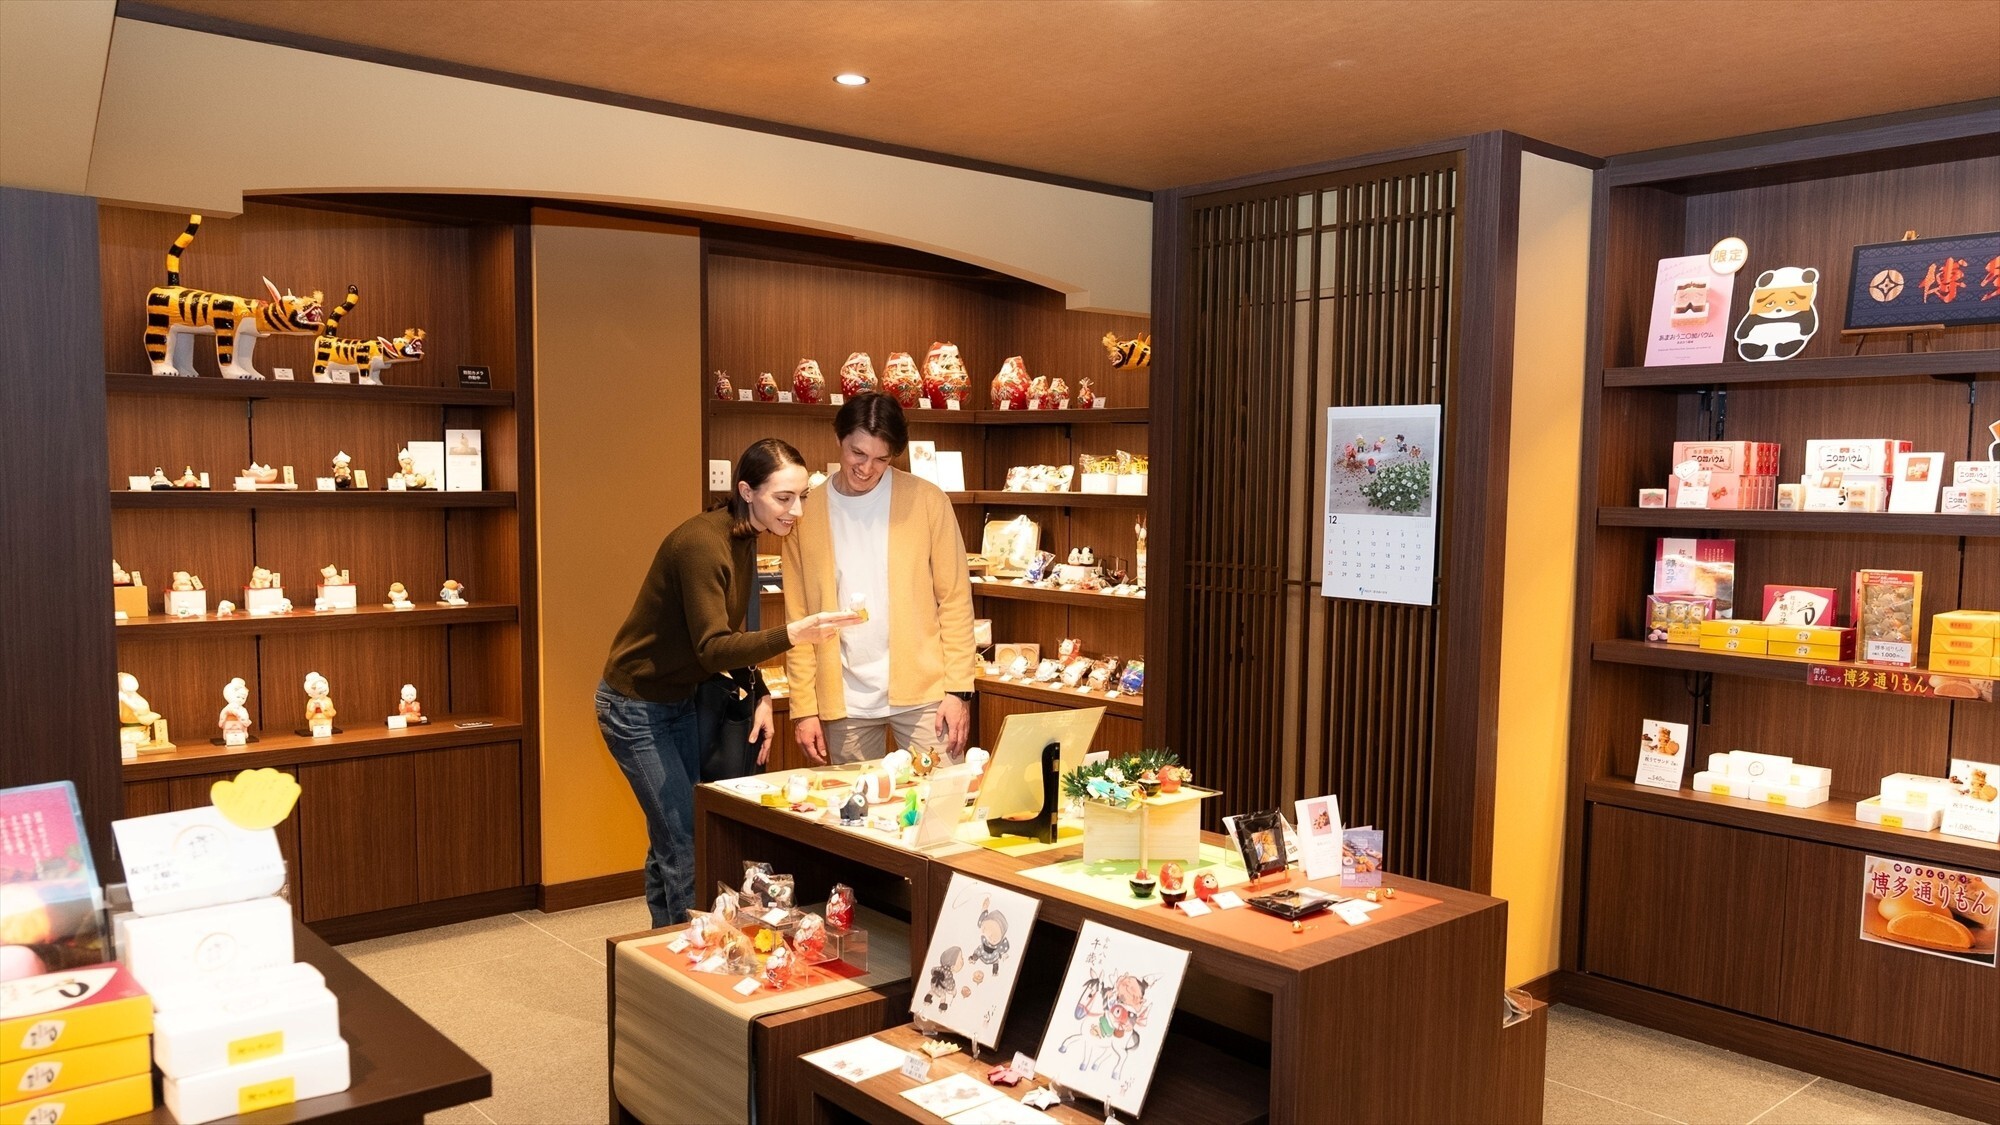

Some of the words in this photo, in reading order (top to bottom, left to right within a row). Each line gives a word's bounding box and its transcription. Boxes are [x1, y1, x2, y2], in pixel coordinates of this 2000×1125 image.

[1713, 249, 1743, 263] 限定
[1329, 515, 1337, 524] 12
[1813, 667, 1827, 675] 傑作
[1813, 675, 1842, 683] まんじゅう
[1843, 669, 1928, 693] 博多通りもん
[1871, 871, 1993, 916] 博多通りもん
